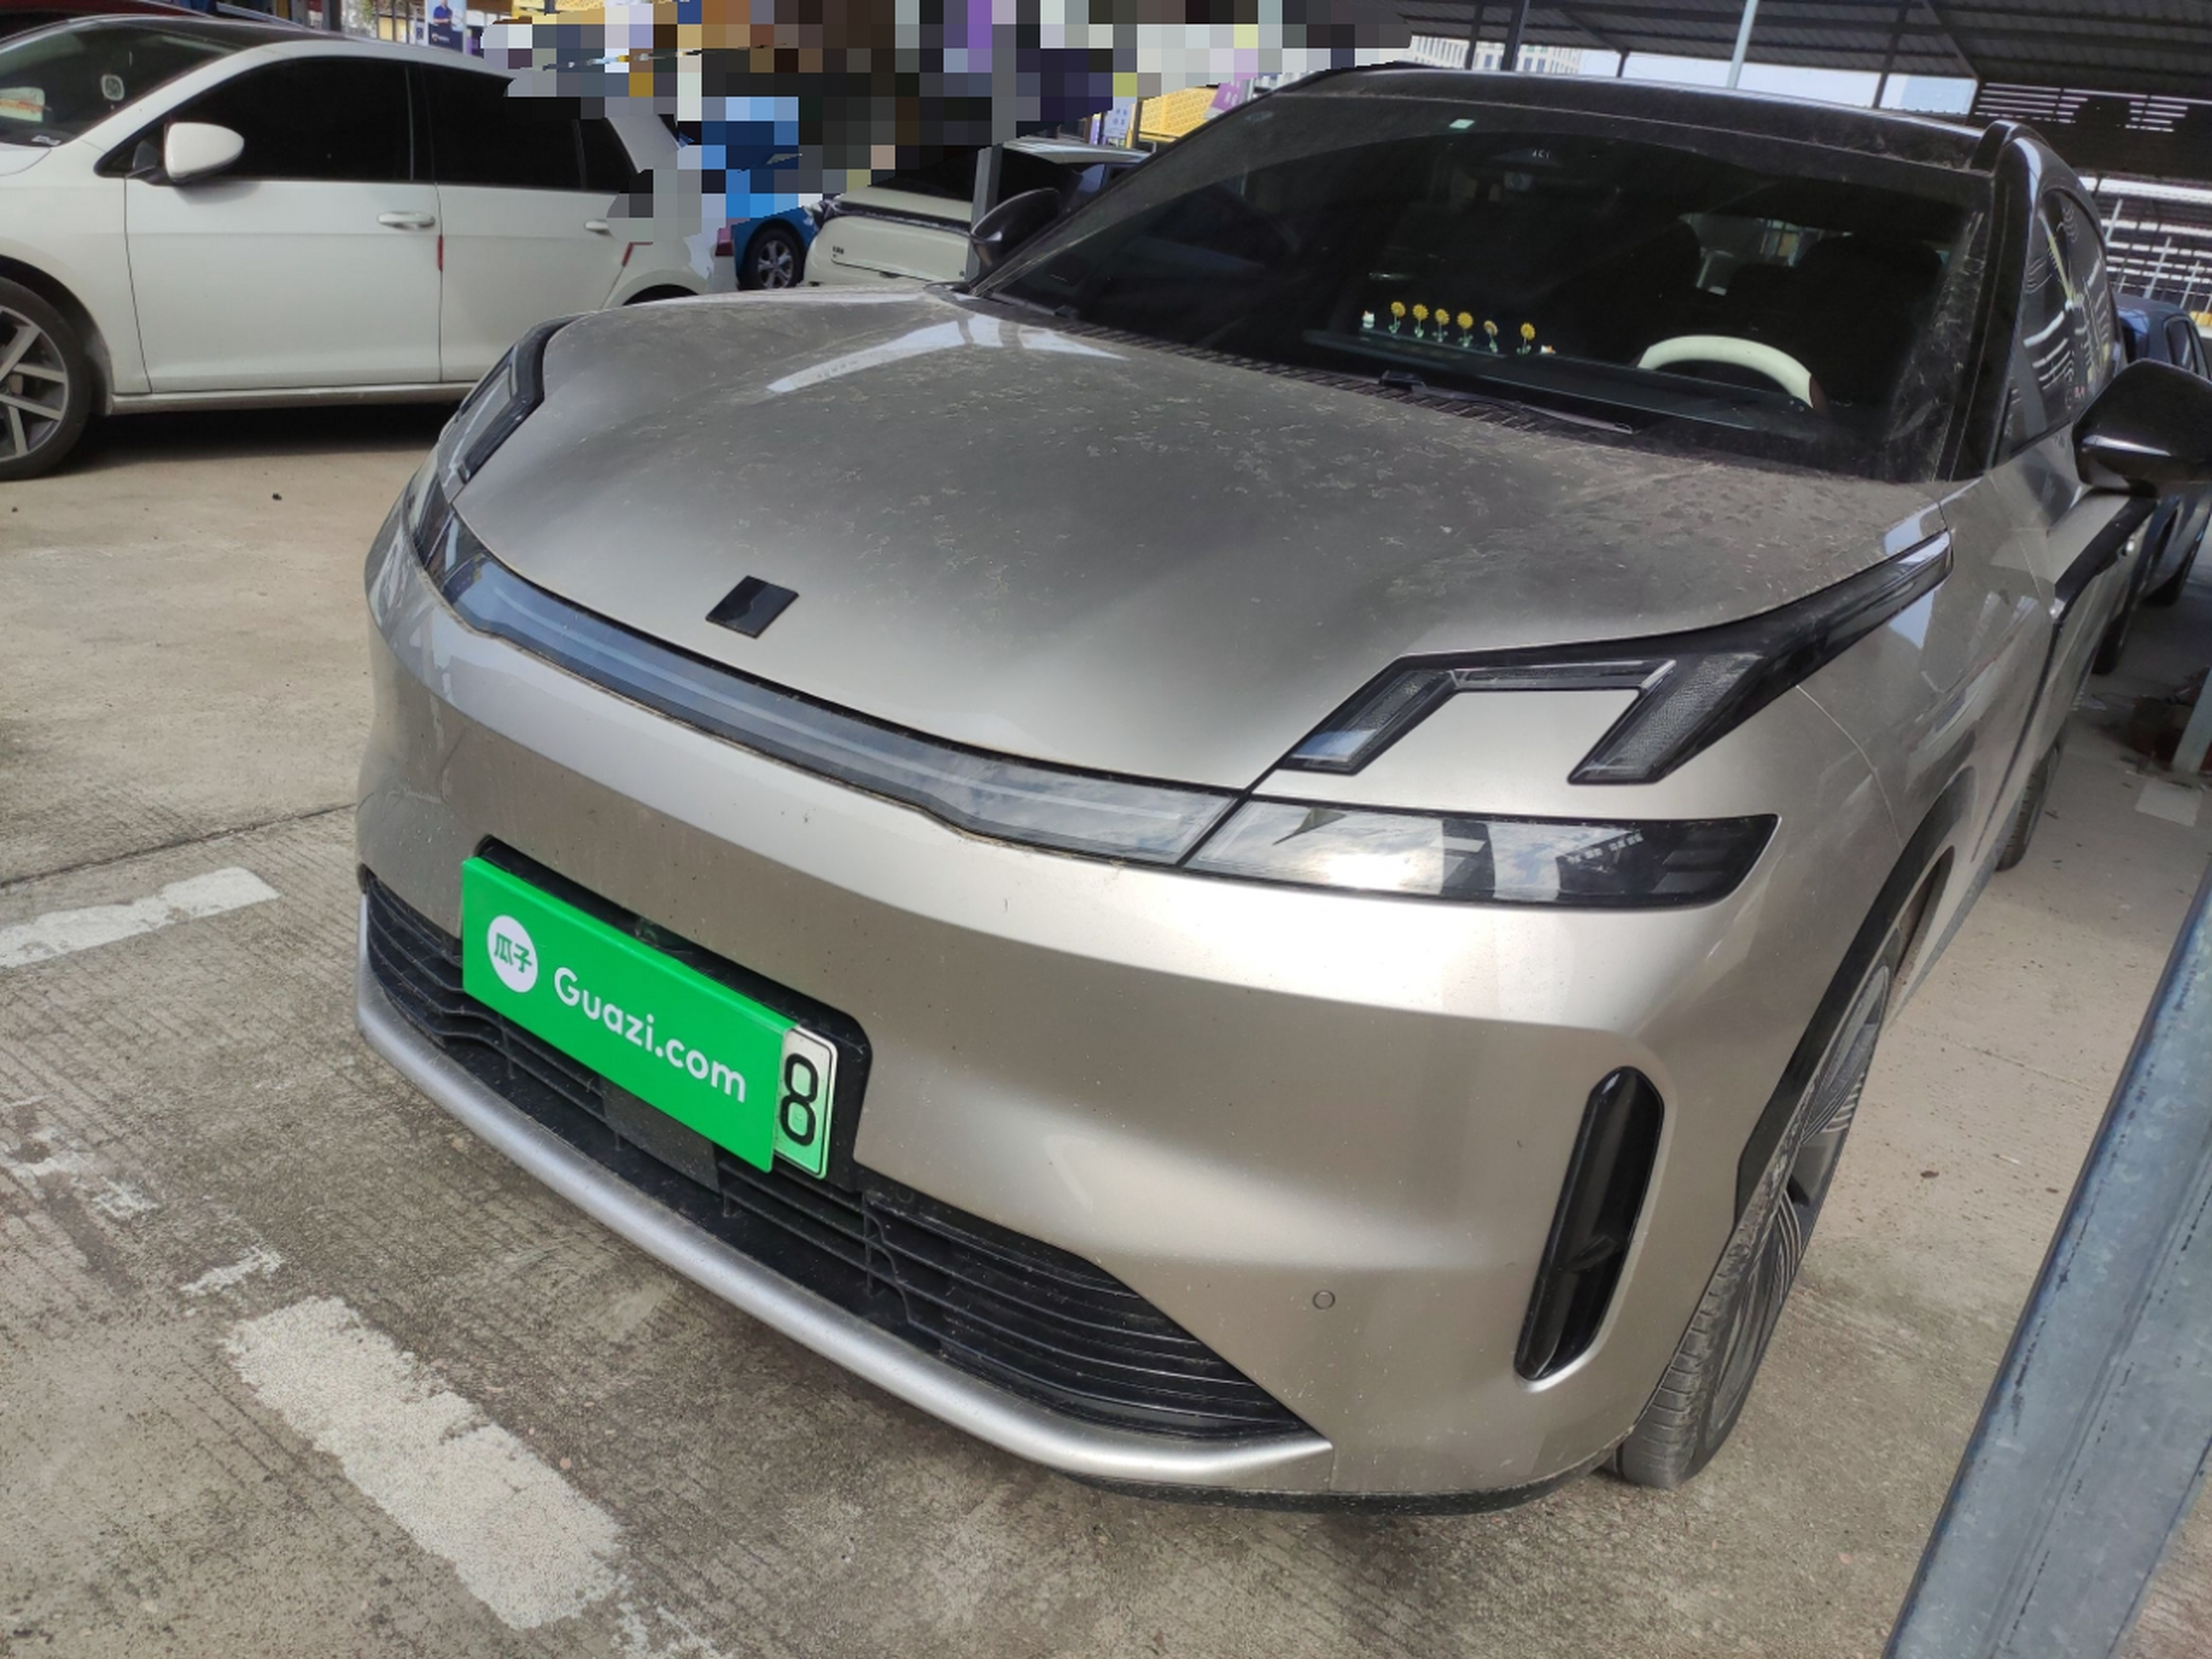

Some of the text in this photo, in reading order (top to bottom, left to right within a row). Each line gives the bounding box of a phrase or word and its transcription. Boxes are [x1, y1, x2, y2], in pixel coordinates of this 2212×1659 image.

[493, 932, 532, 974] 瓜子
[554, 967, 745, 1103] Guazi.com
[780, 1052, 819, 1147] 8
